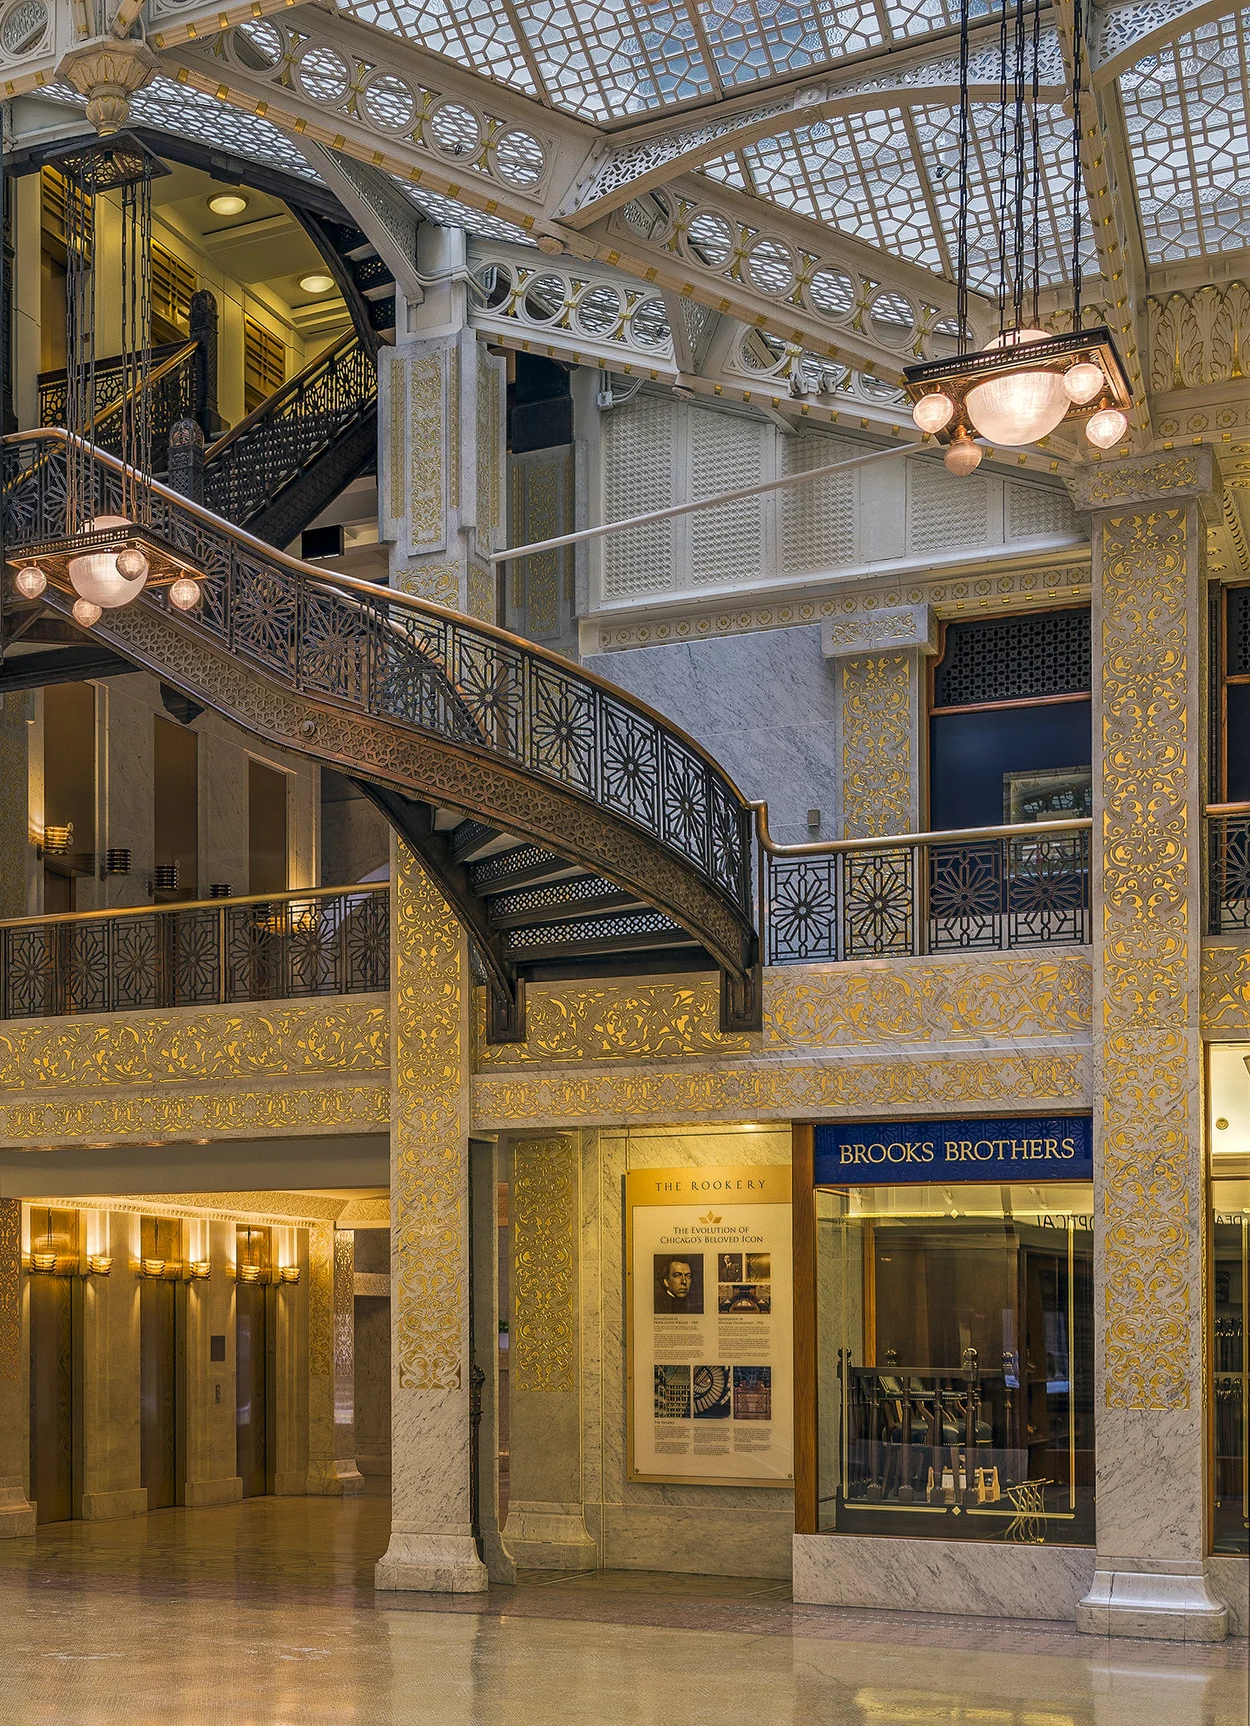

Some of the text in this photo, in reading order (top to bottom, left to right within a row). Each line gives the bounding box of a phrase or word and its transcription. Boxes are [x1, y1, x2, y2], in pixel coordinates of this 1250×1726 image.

[839, 1138, 1075, 1164] BROOKS BROTHERS
[655, 1180, 765, 1191] THE ROOKERY
[673, 1226, 688, 1234] THE
[691, 1226, 736, 1234] EVOLUTION
[704, 1235, 739, 1243] BELOVED
[742, 1235, 763, 1243] ICON
